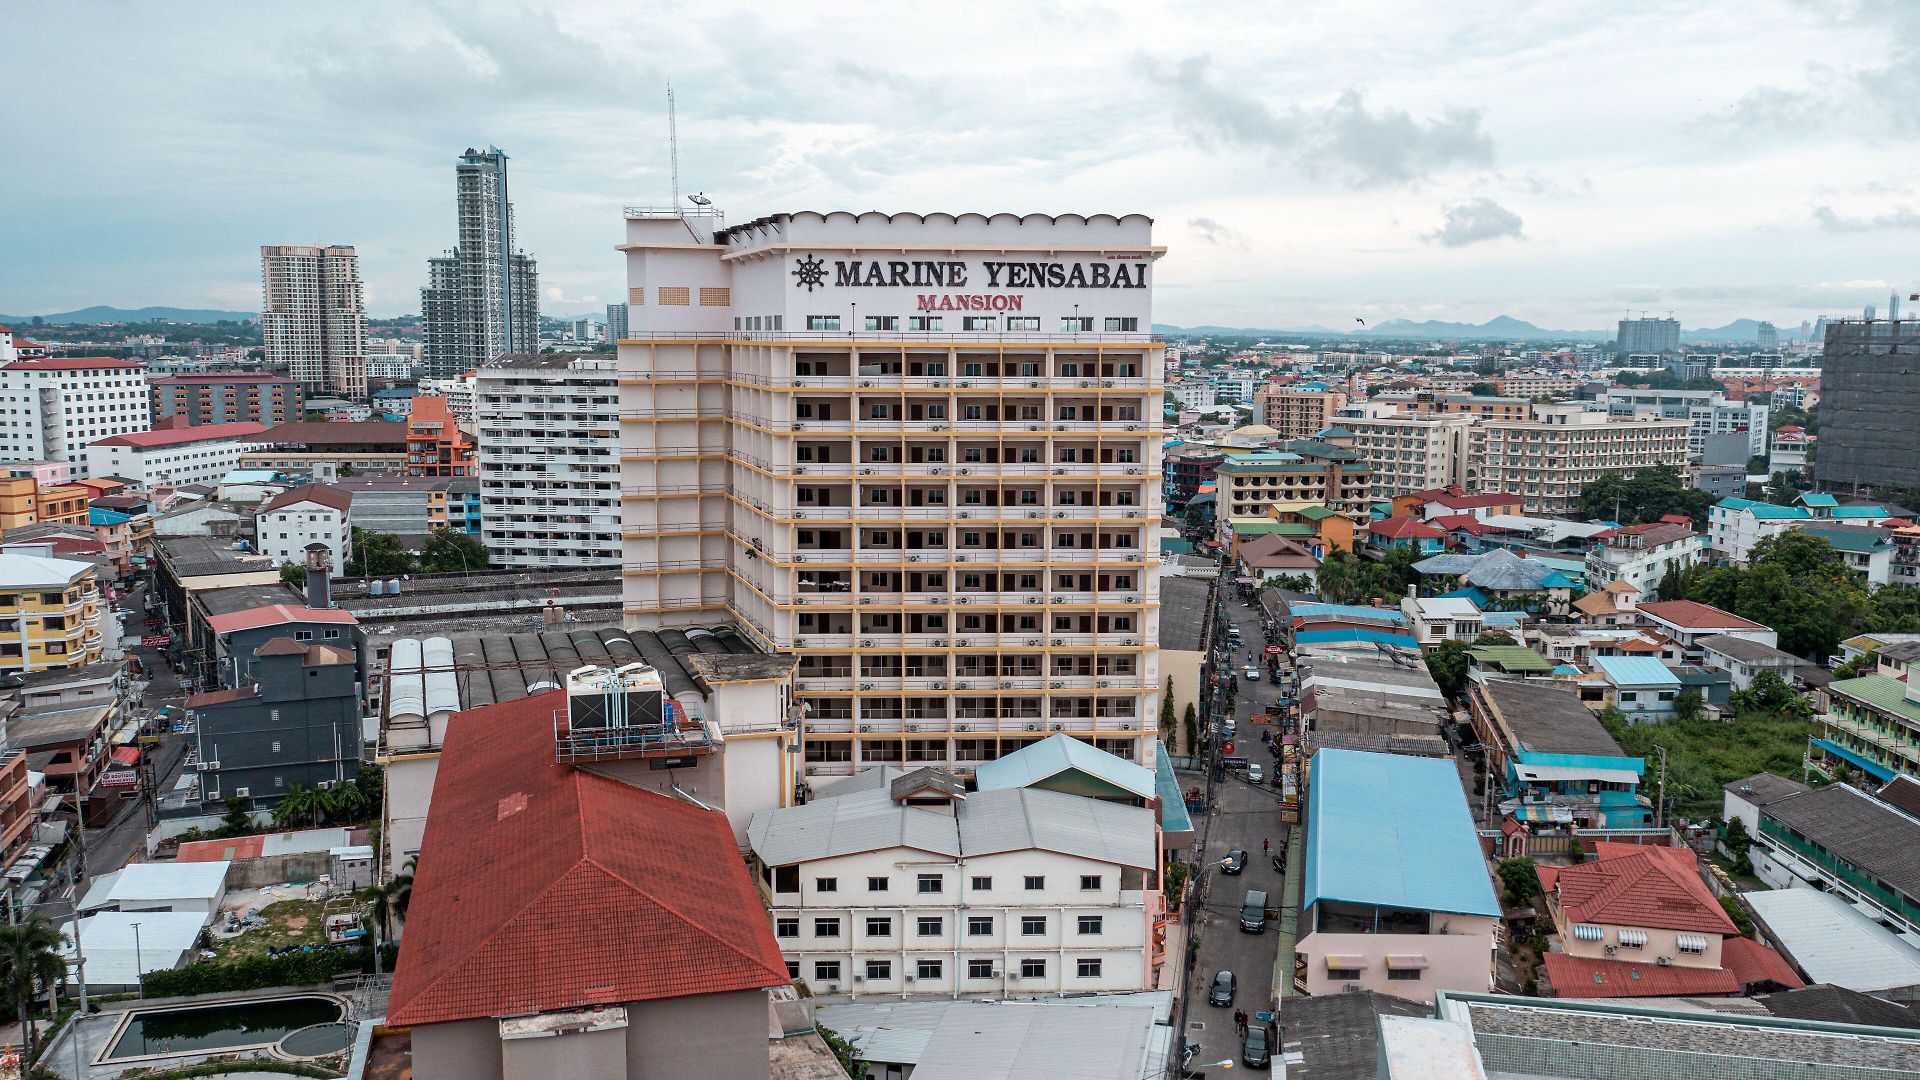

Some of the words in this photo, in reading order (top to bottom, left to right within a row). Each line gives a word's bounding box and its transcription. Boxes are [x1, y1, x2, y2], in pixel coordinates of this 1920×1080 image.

[835, 261, 968, 287] MARINE
[983, 261, 1148, 289] YENSABAI
[917, 294, 1023, 311] MANSION
